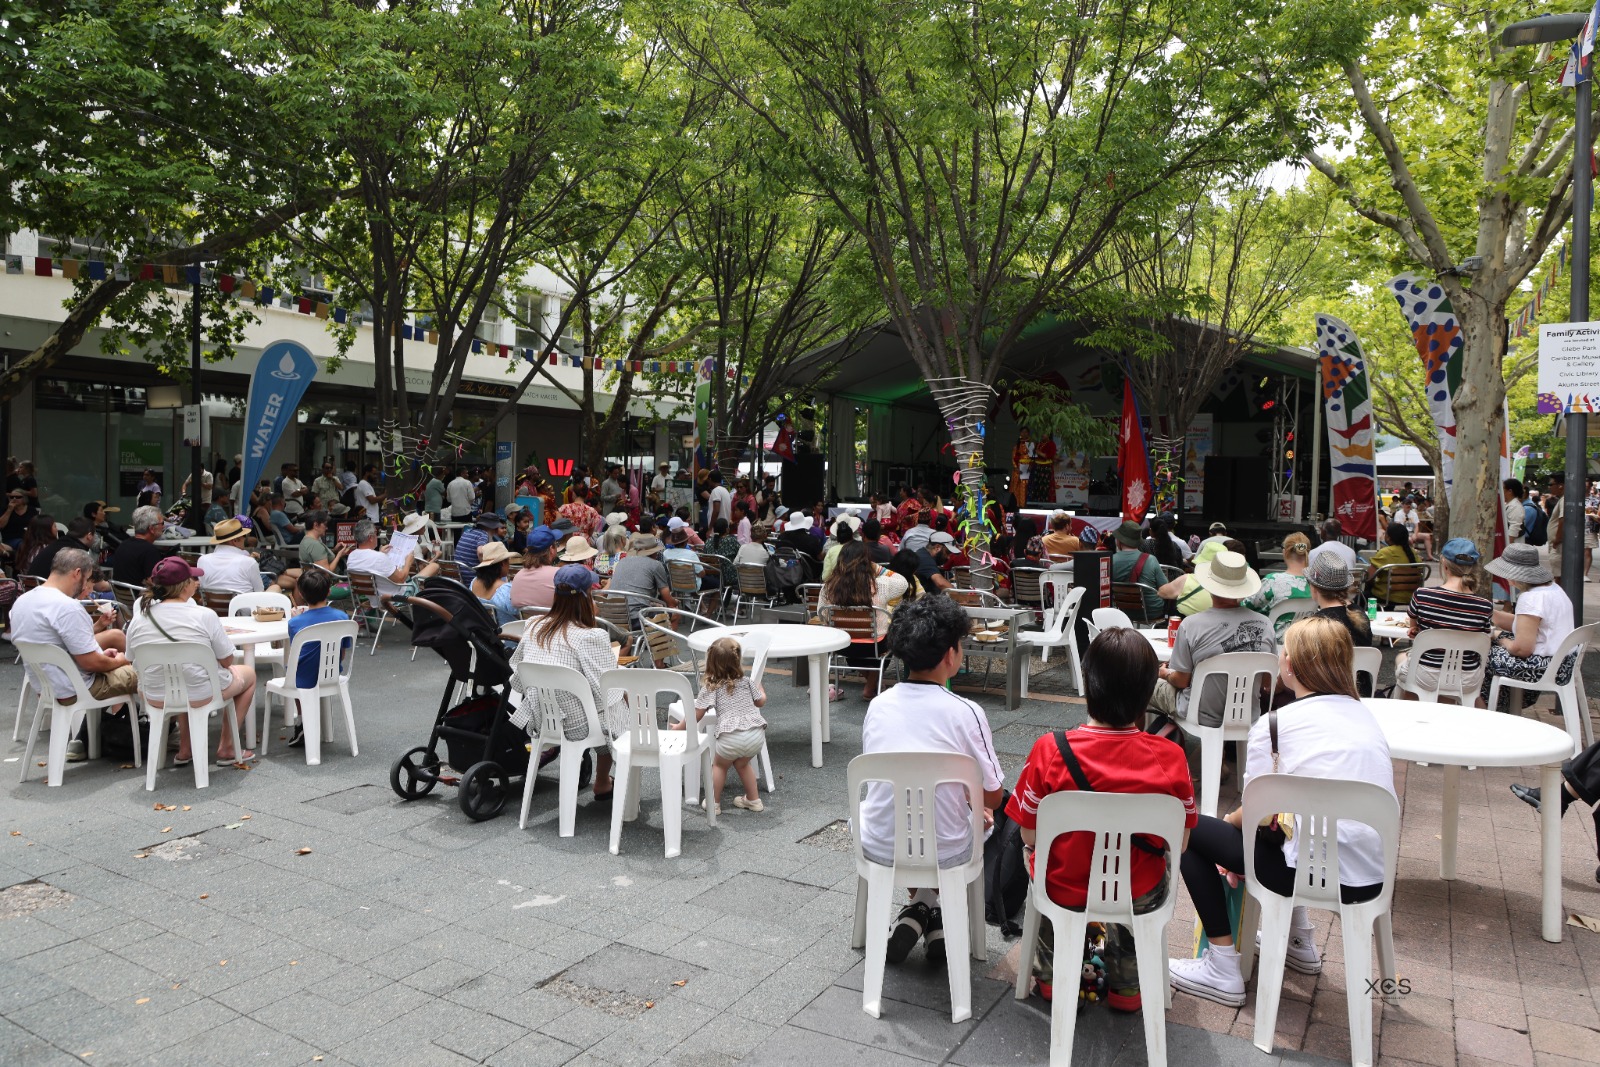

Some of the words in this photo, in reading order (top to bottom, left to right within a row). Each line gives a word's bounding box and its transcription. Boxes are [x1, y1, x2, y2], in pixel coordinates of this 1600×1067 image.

[1546, 330, 1574, 338] Family
[1576, 371, 1599, 379] Library
[251, 393, 284, 458] WATER
[121, 457, 142, 465] LEASE
